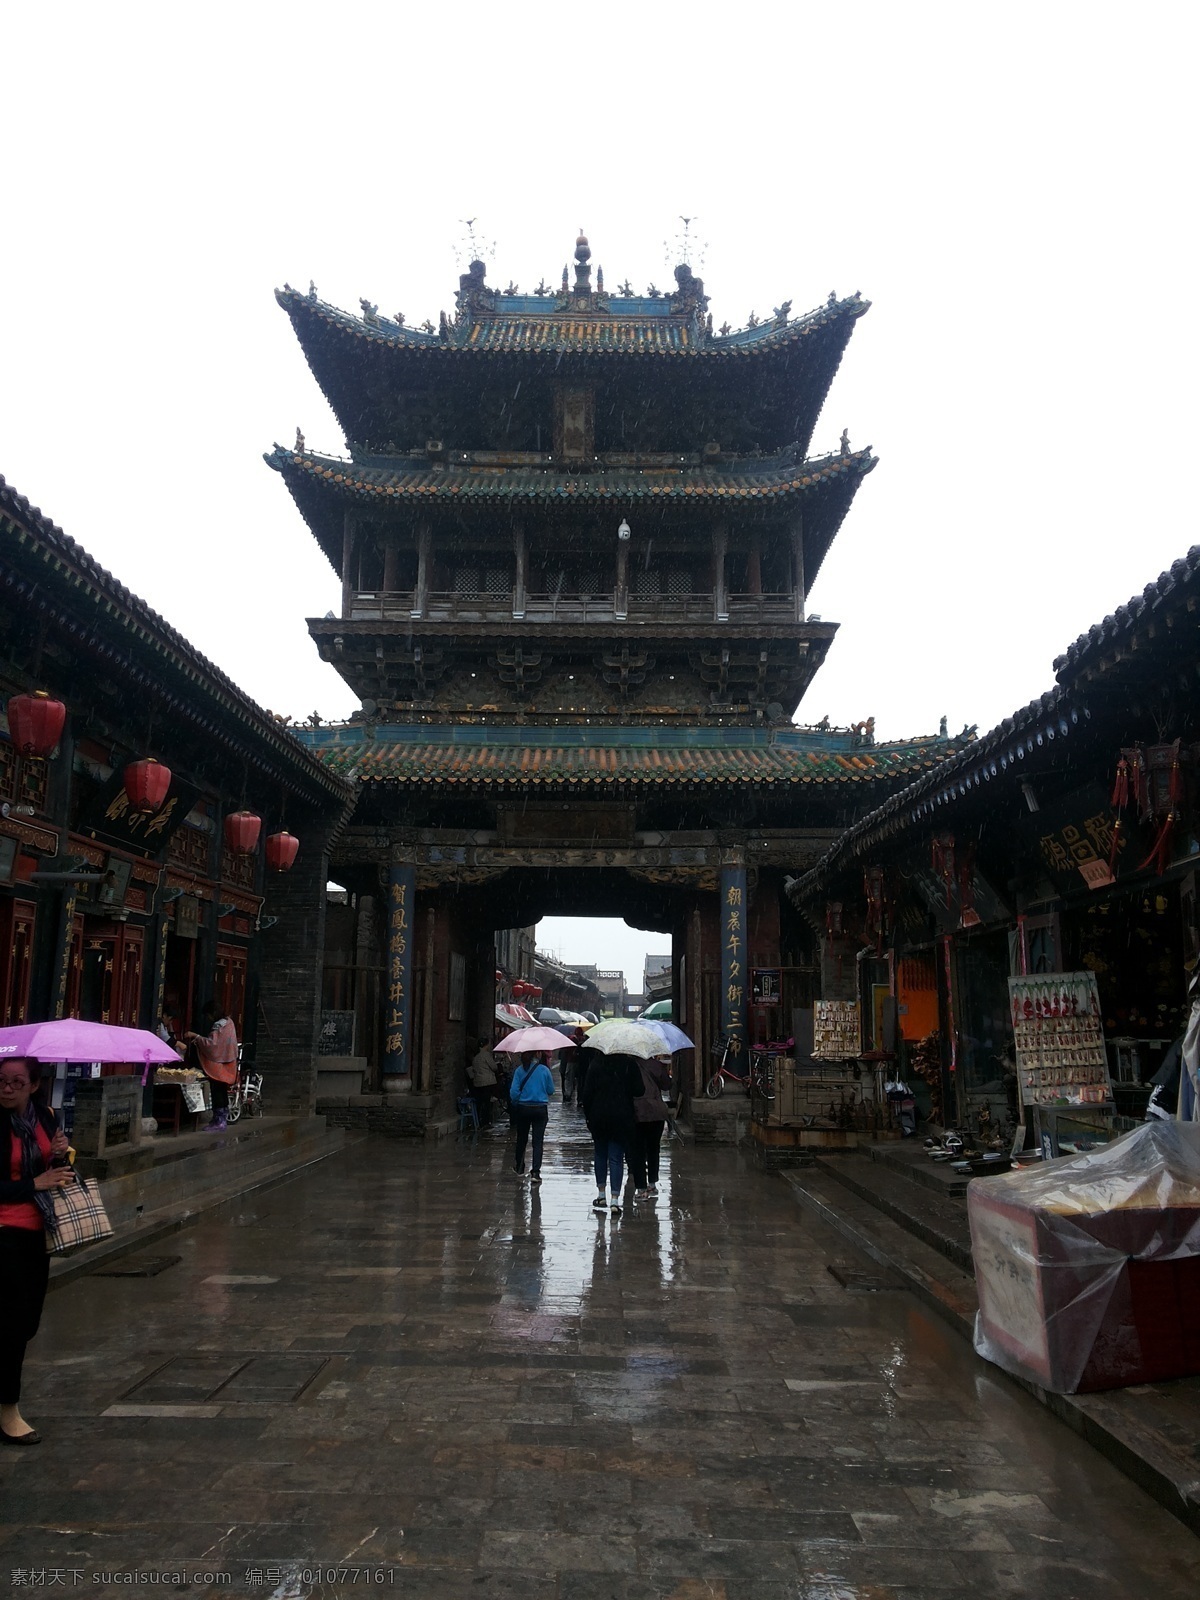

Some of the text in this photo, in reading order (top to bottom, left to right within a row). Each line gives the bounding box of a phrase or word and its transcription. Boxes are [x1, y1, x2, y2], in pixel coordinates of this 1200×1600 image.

[725, 886, 744, 1058] 朝晨午夕街三市
